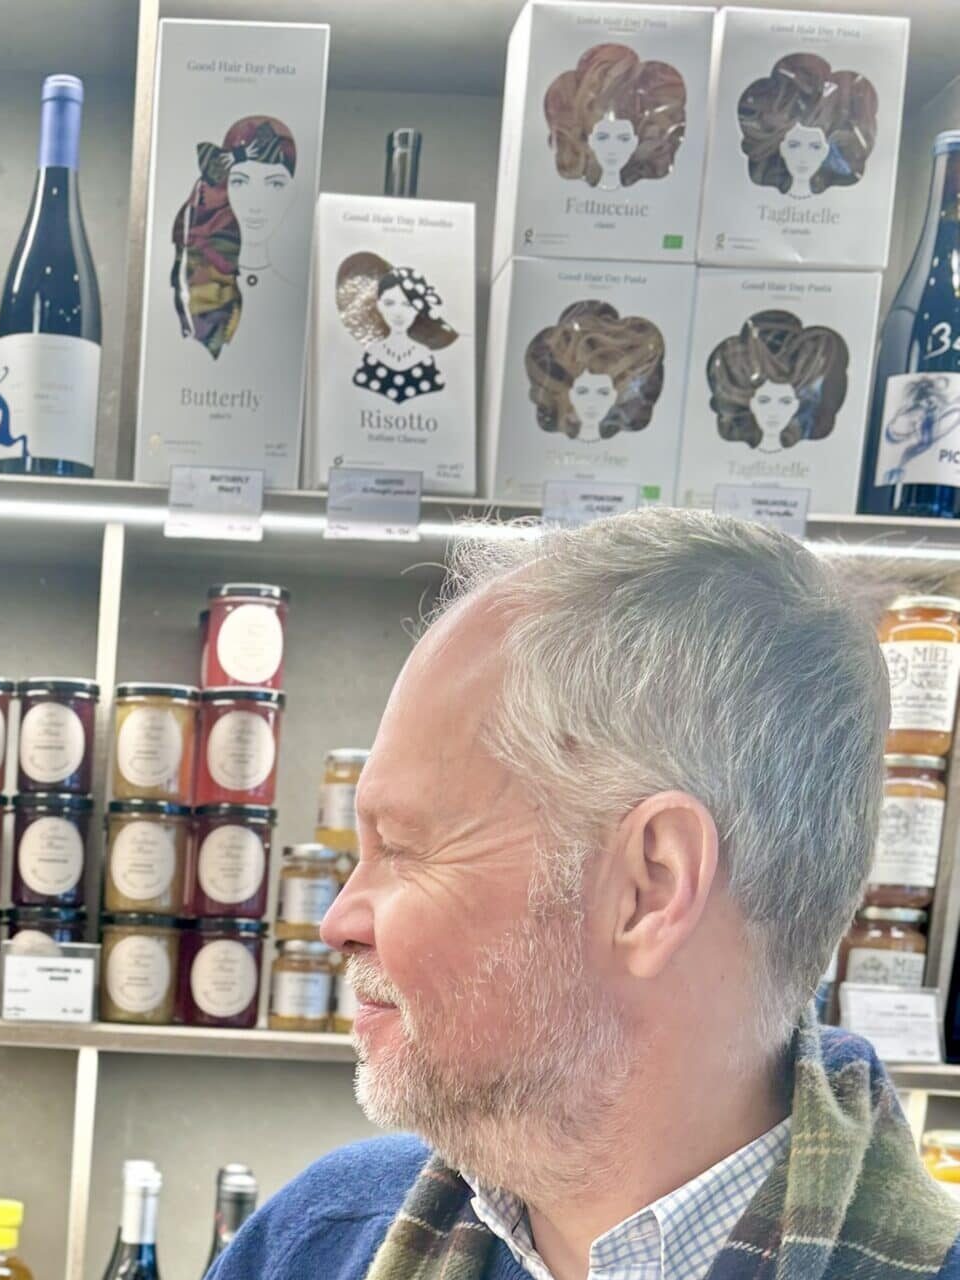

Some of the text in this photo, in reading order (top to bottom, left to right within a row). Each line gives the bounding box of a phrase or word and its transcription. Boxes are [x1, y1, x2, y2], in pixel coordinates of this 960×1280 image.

[186, 60, 296, 77] Good Hair Day Pasta
[758, 205, 841, 226] Tagliatelle
[180, 387, 262, 413] Butterfly
[360, 409, 439, 433] Risotto
